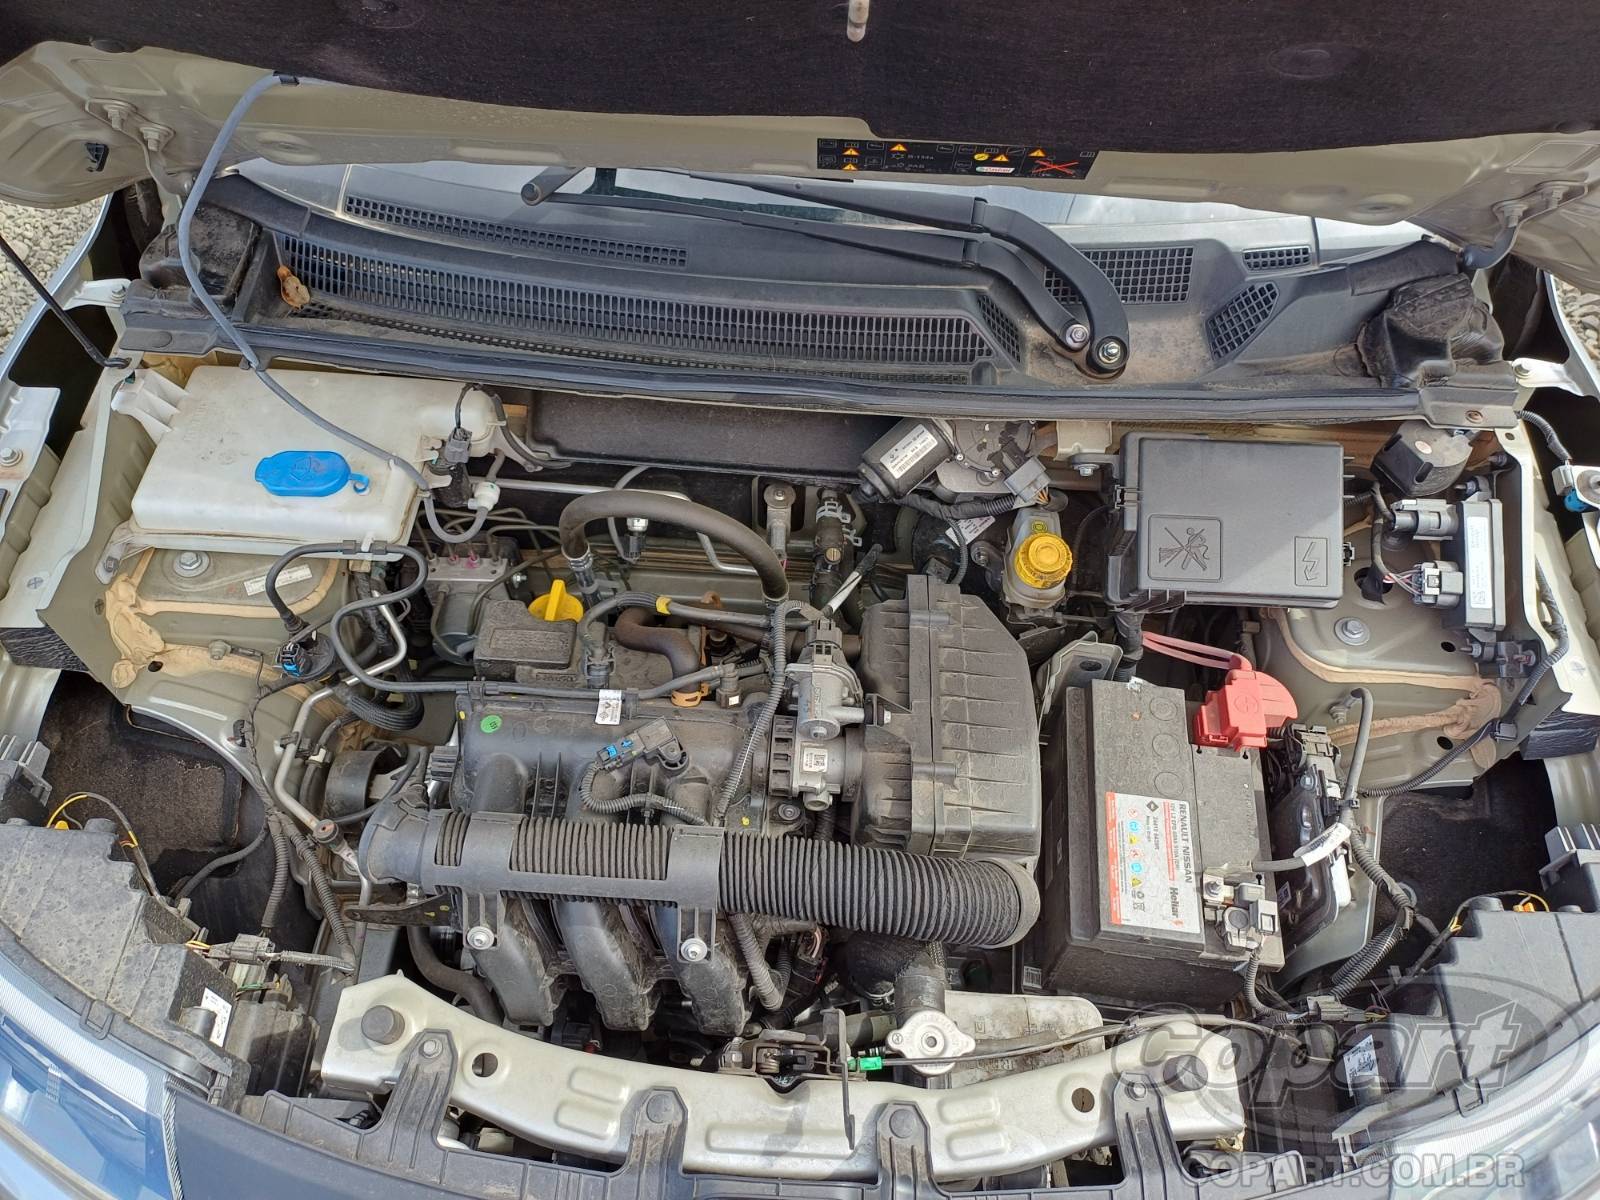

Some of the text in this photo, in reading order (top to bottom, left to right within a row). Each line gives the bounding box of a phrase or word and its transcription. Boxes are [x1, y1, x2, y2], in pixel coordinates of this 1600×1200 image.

[1179, 803, 1192, 883] RENAULT NISSAN
[1169, 887, 1179, 918] Heliar
